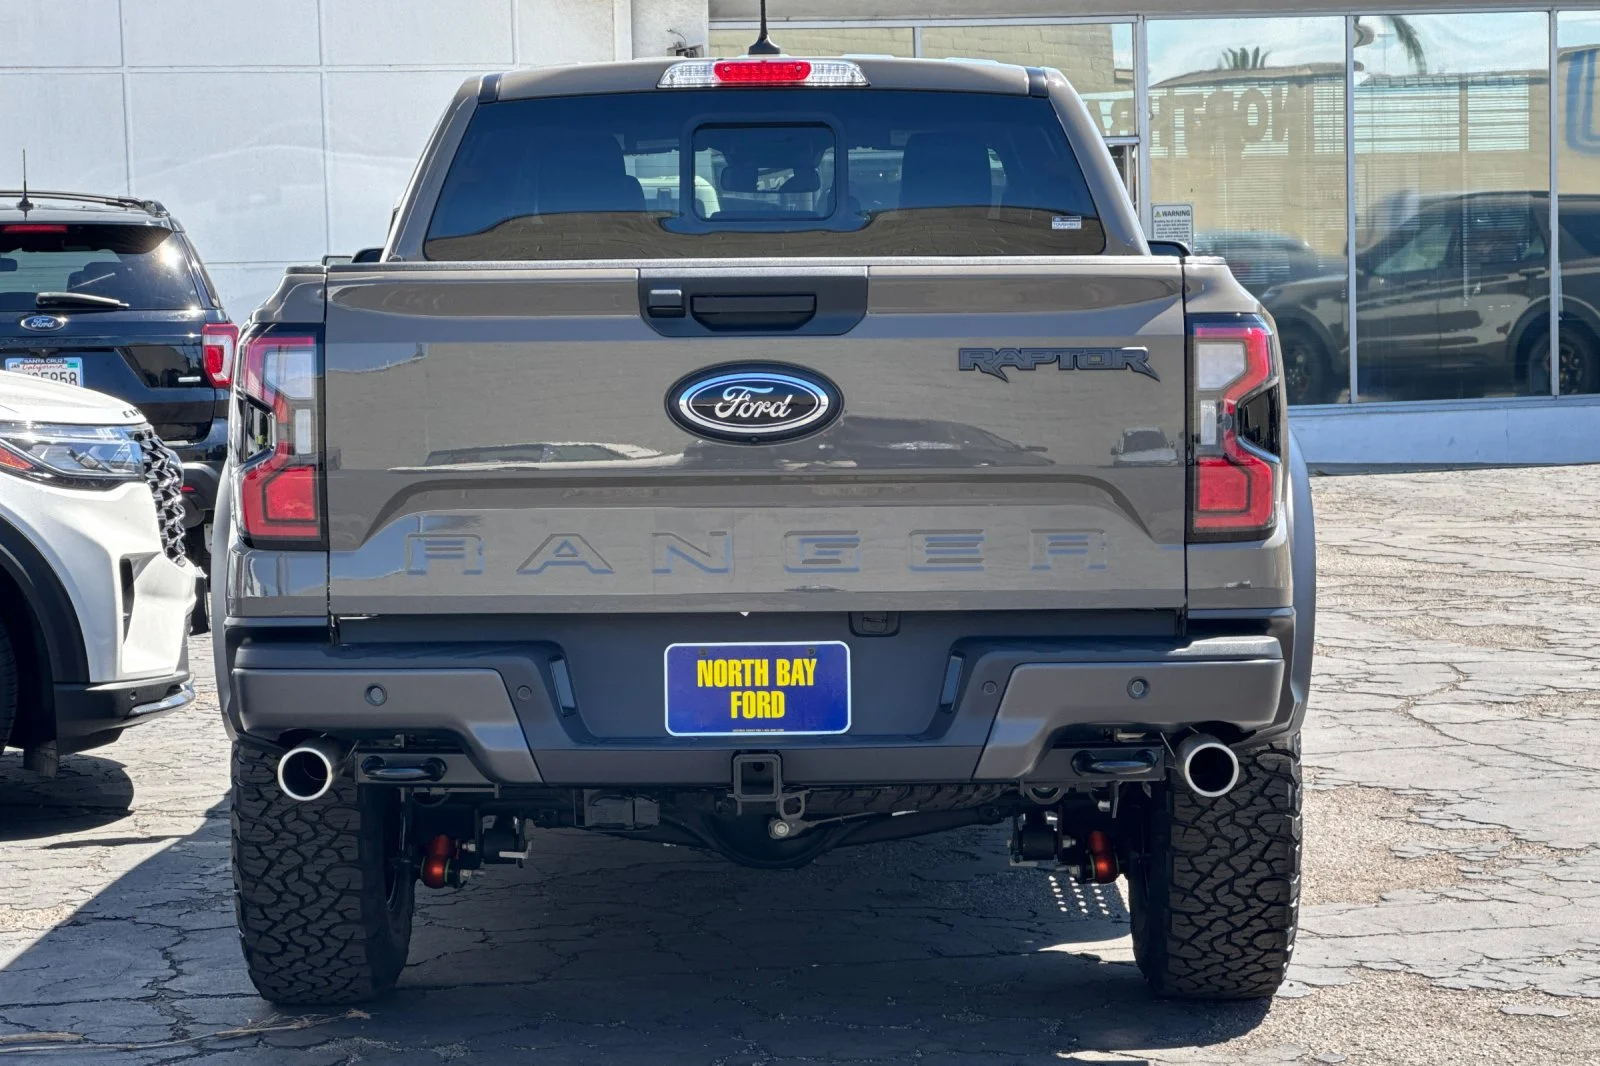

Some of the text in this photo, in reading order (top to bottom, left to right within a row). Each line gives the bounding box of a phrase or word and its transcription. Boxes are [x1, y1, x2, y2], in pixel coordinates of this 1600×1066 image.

[31, 318, 54, 328] Ford
[958, 346, 1161, 383] RAPTOR
[715, 386, 793, 418] Ford
[406, 528, 1108, 574] RANGER
[697, 658, 817, 687] NORTH BAY
[730, 690, 785, 719] FORD
